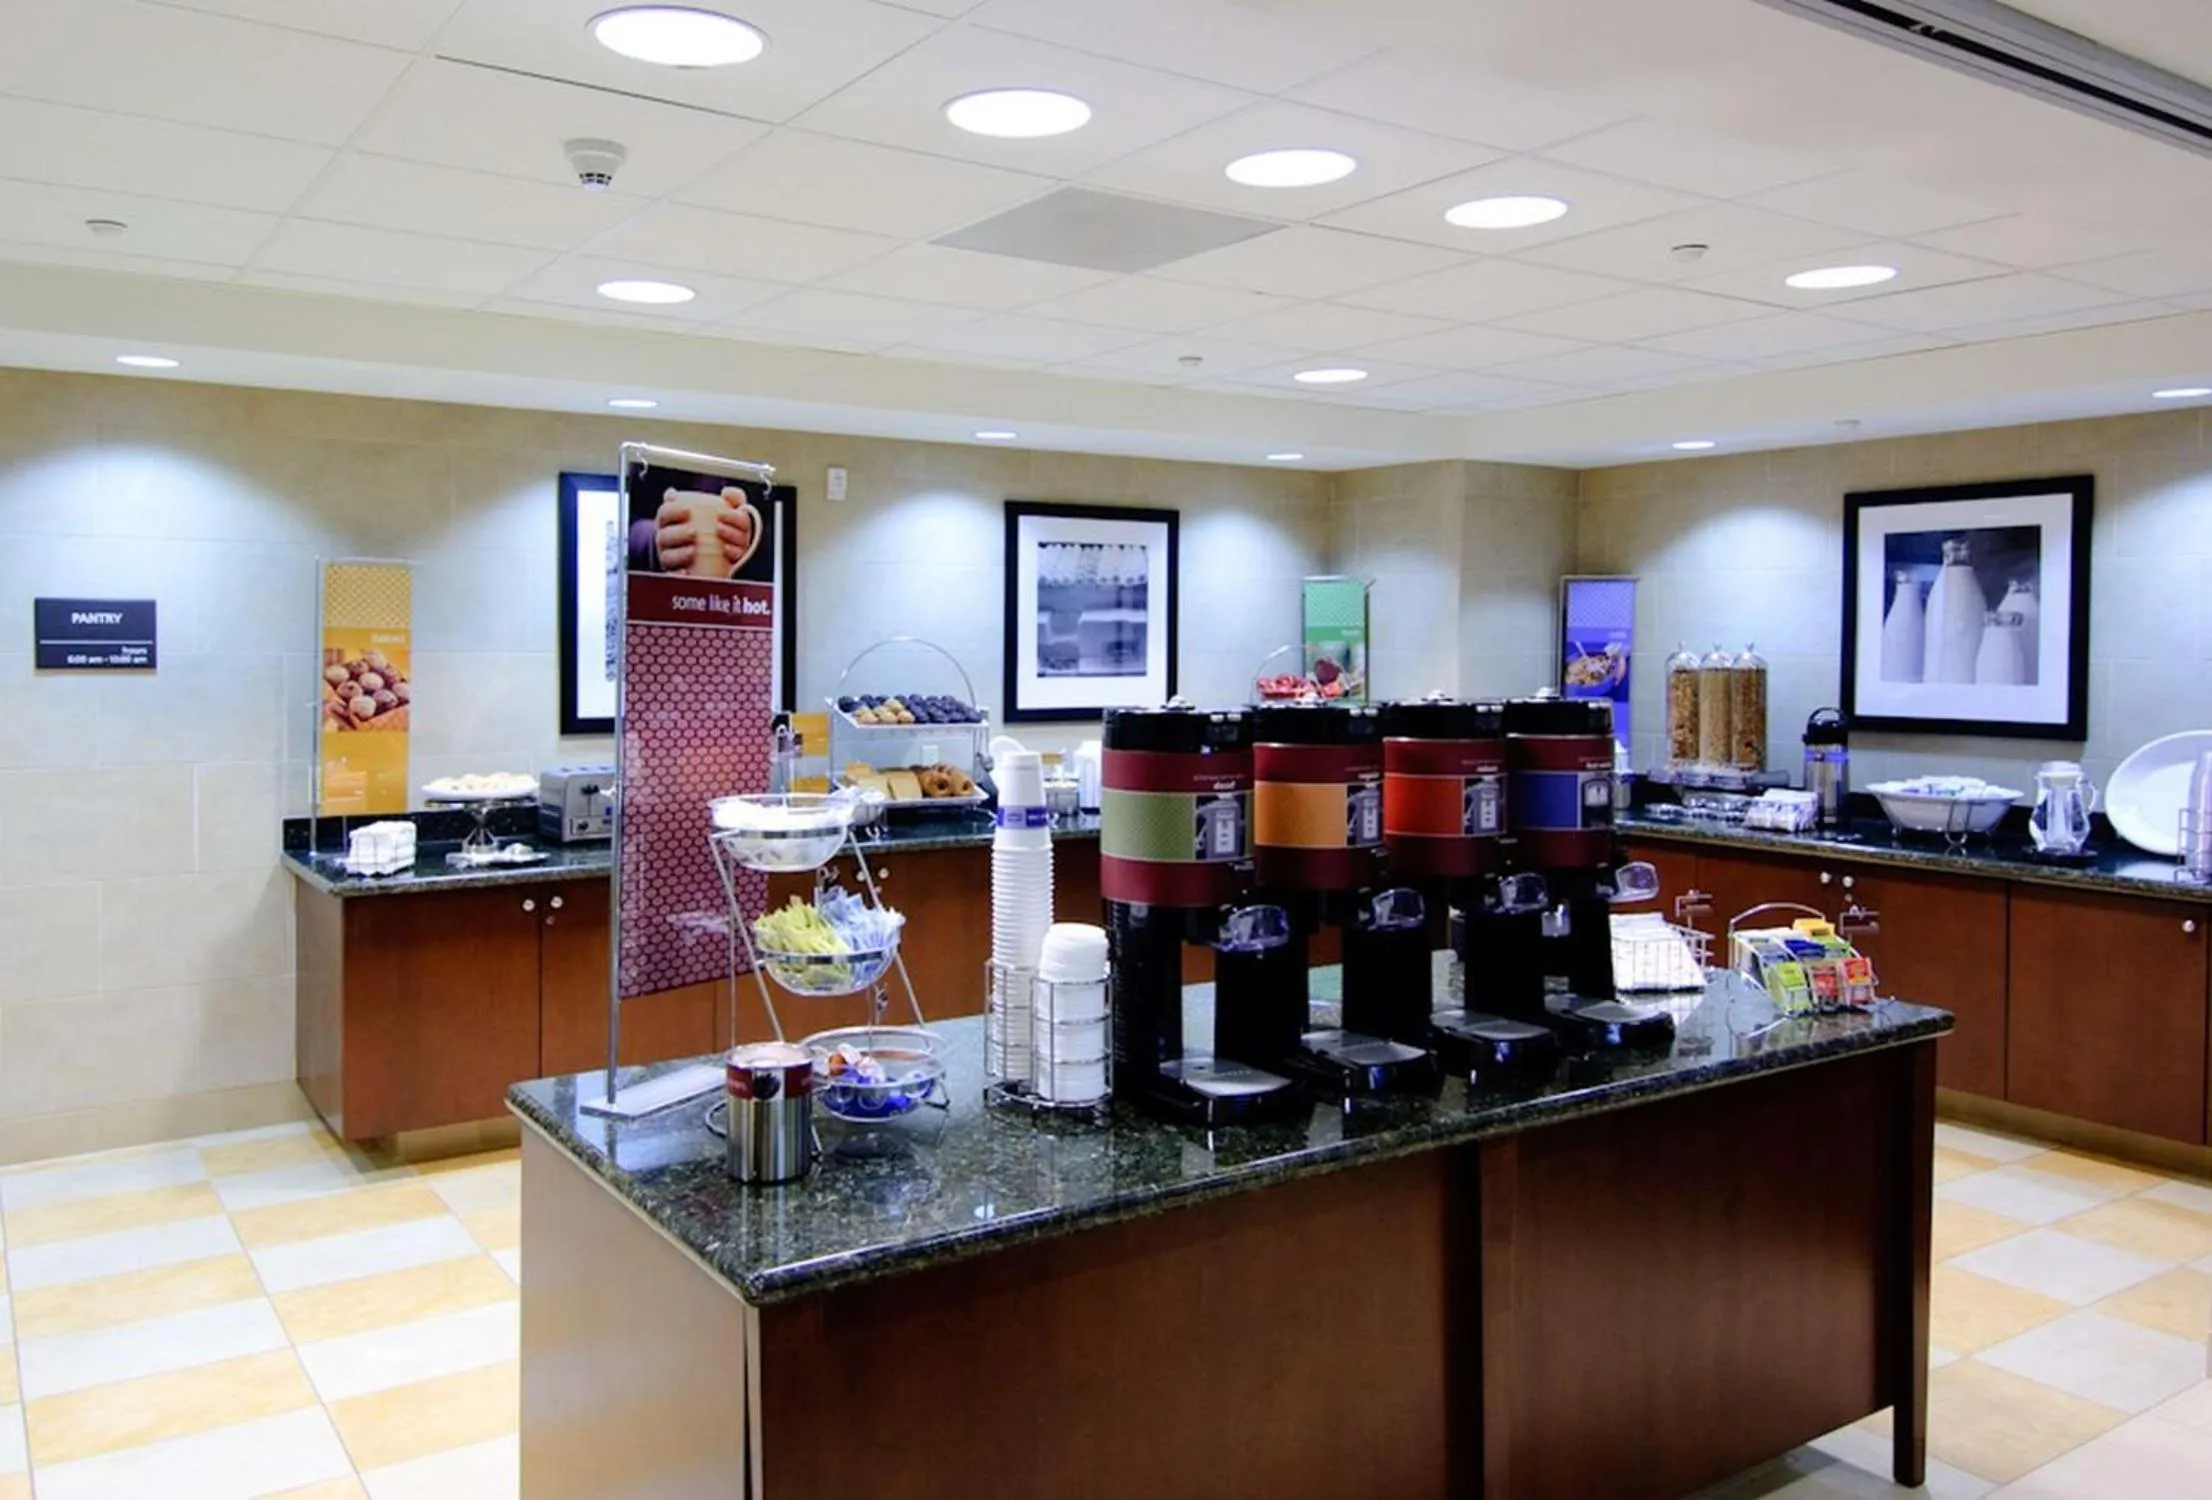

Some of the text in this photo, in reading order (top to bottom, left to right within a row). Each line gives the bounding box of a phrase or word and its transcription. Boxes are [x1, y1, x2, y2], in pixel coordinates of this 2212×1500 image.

[672, 594, 771, 615] some like it hot.
[71, 612, 122, 624] PANTRY
